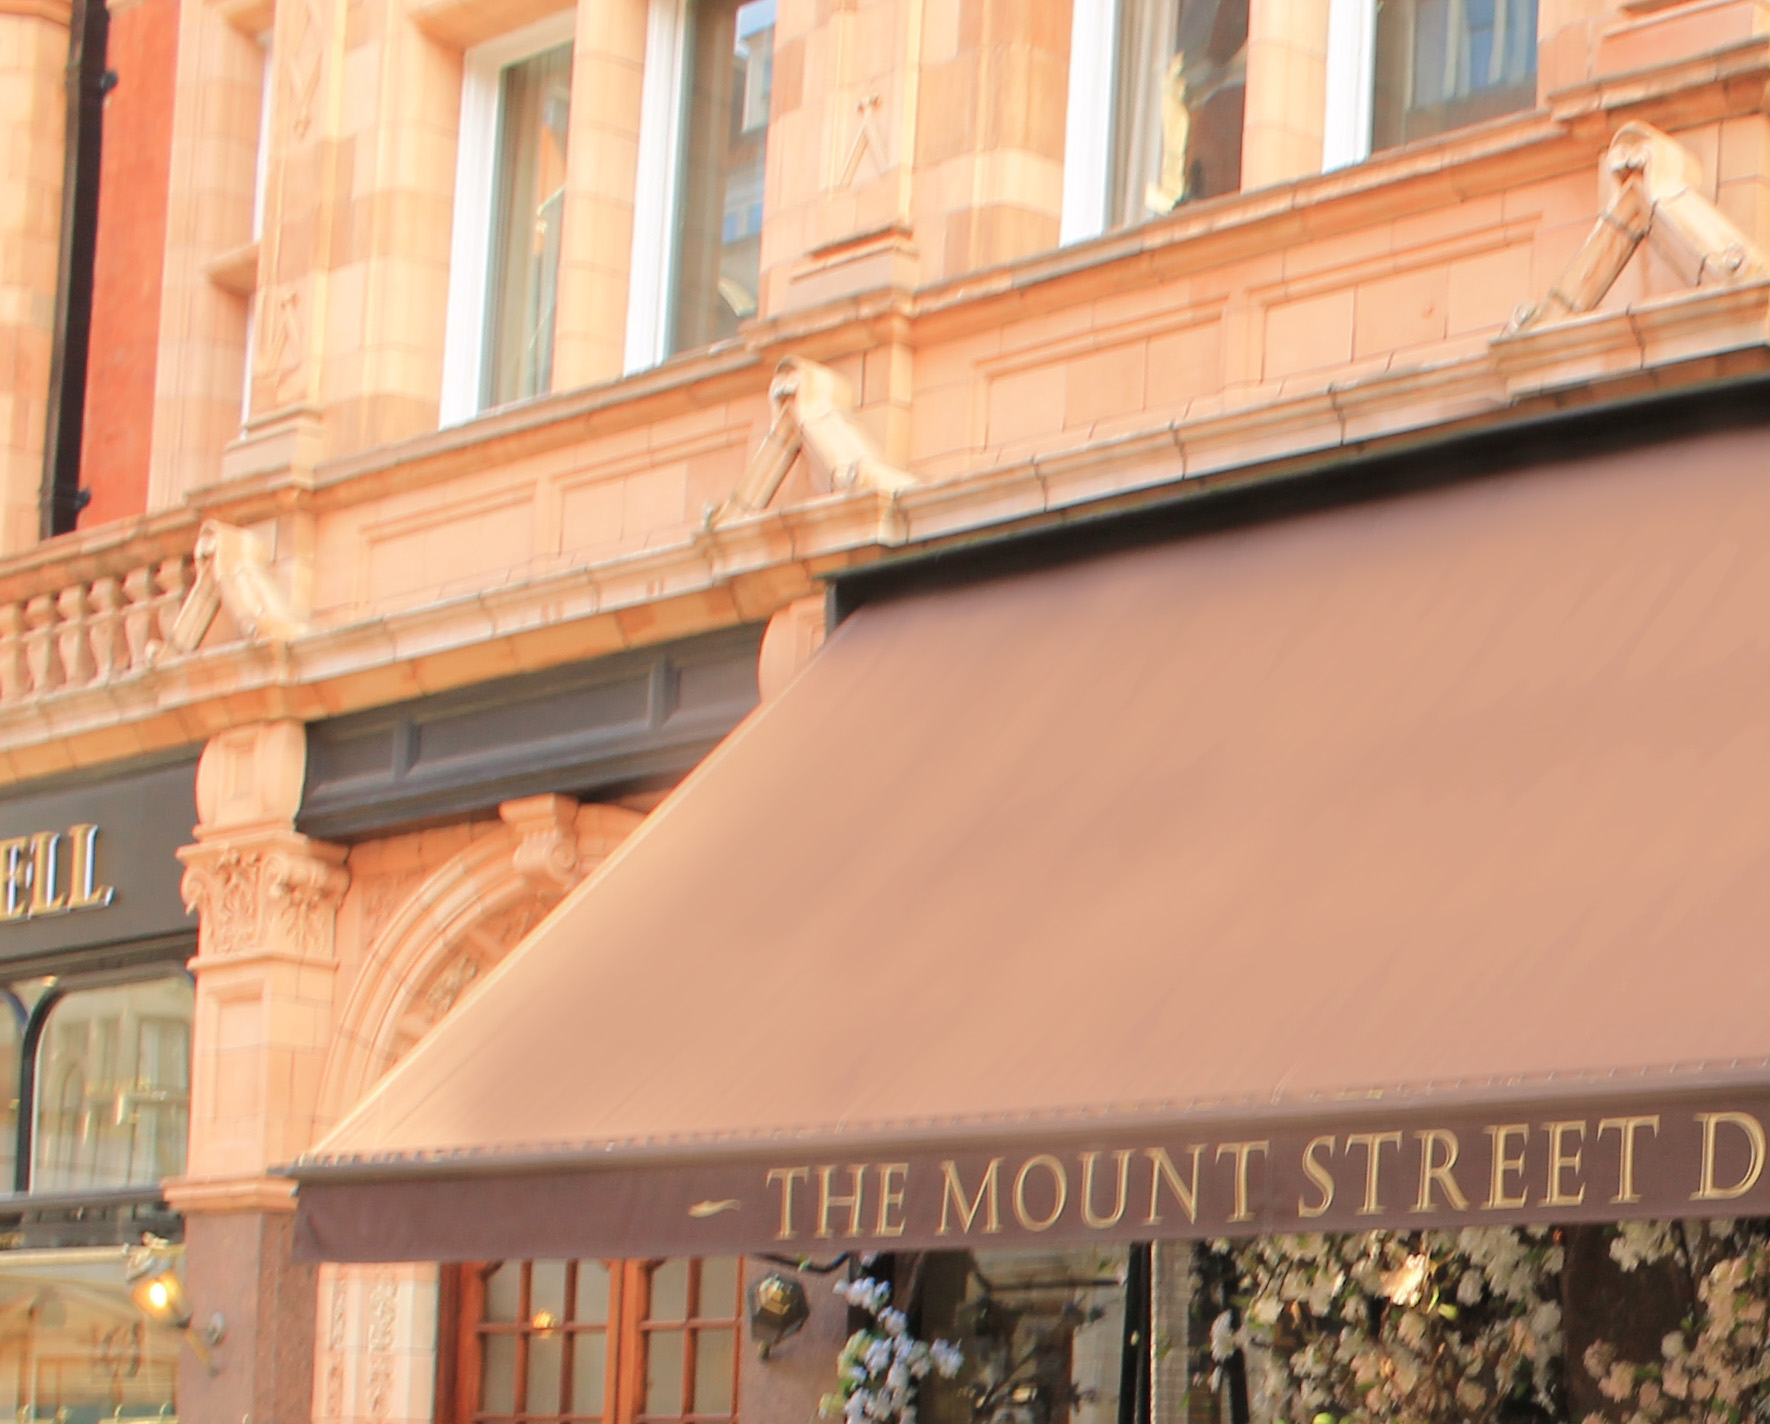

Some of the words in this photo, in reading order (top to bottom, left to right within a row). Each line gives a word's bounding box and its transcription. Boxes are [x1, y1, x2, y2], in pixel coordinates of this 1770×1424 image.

[766, 1162, 909, 1241] THE
[935, 1139, 1270, 1236] MOUNT
[1298, 1114, 1660, 1218] STREET
